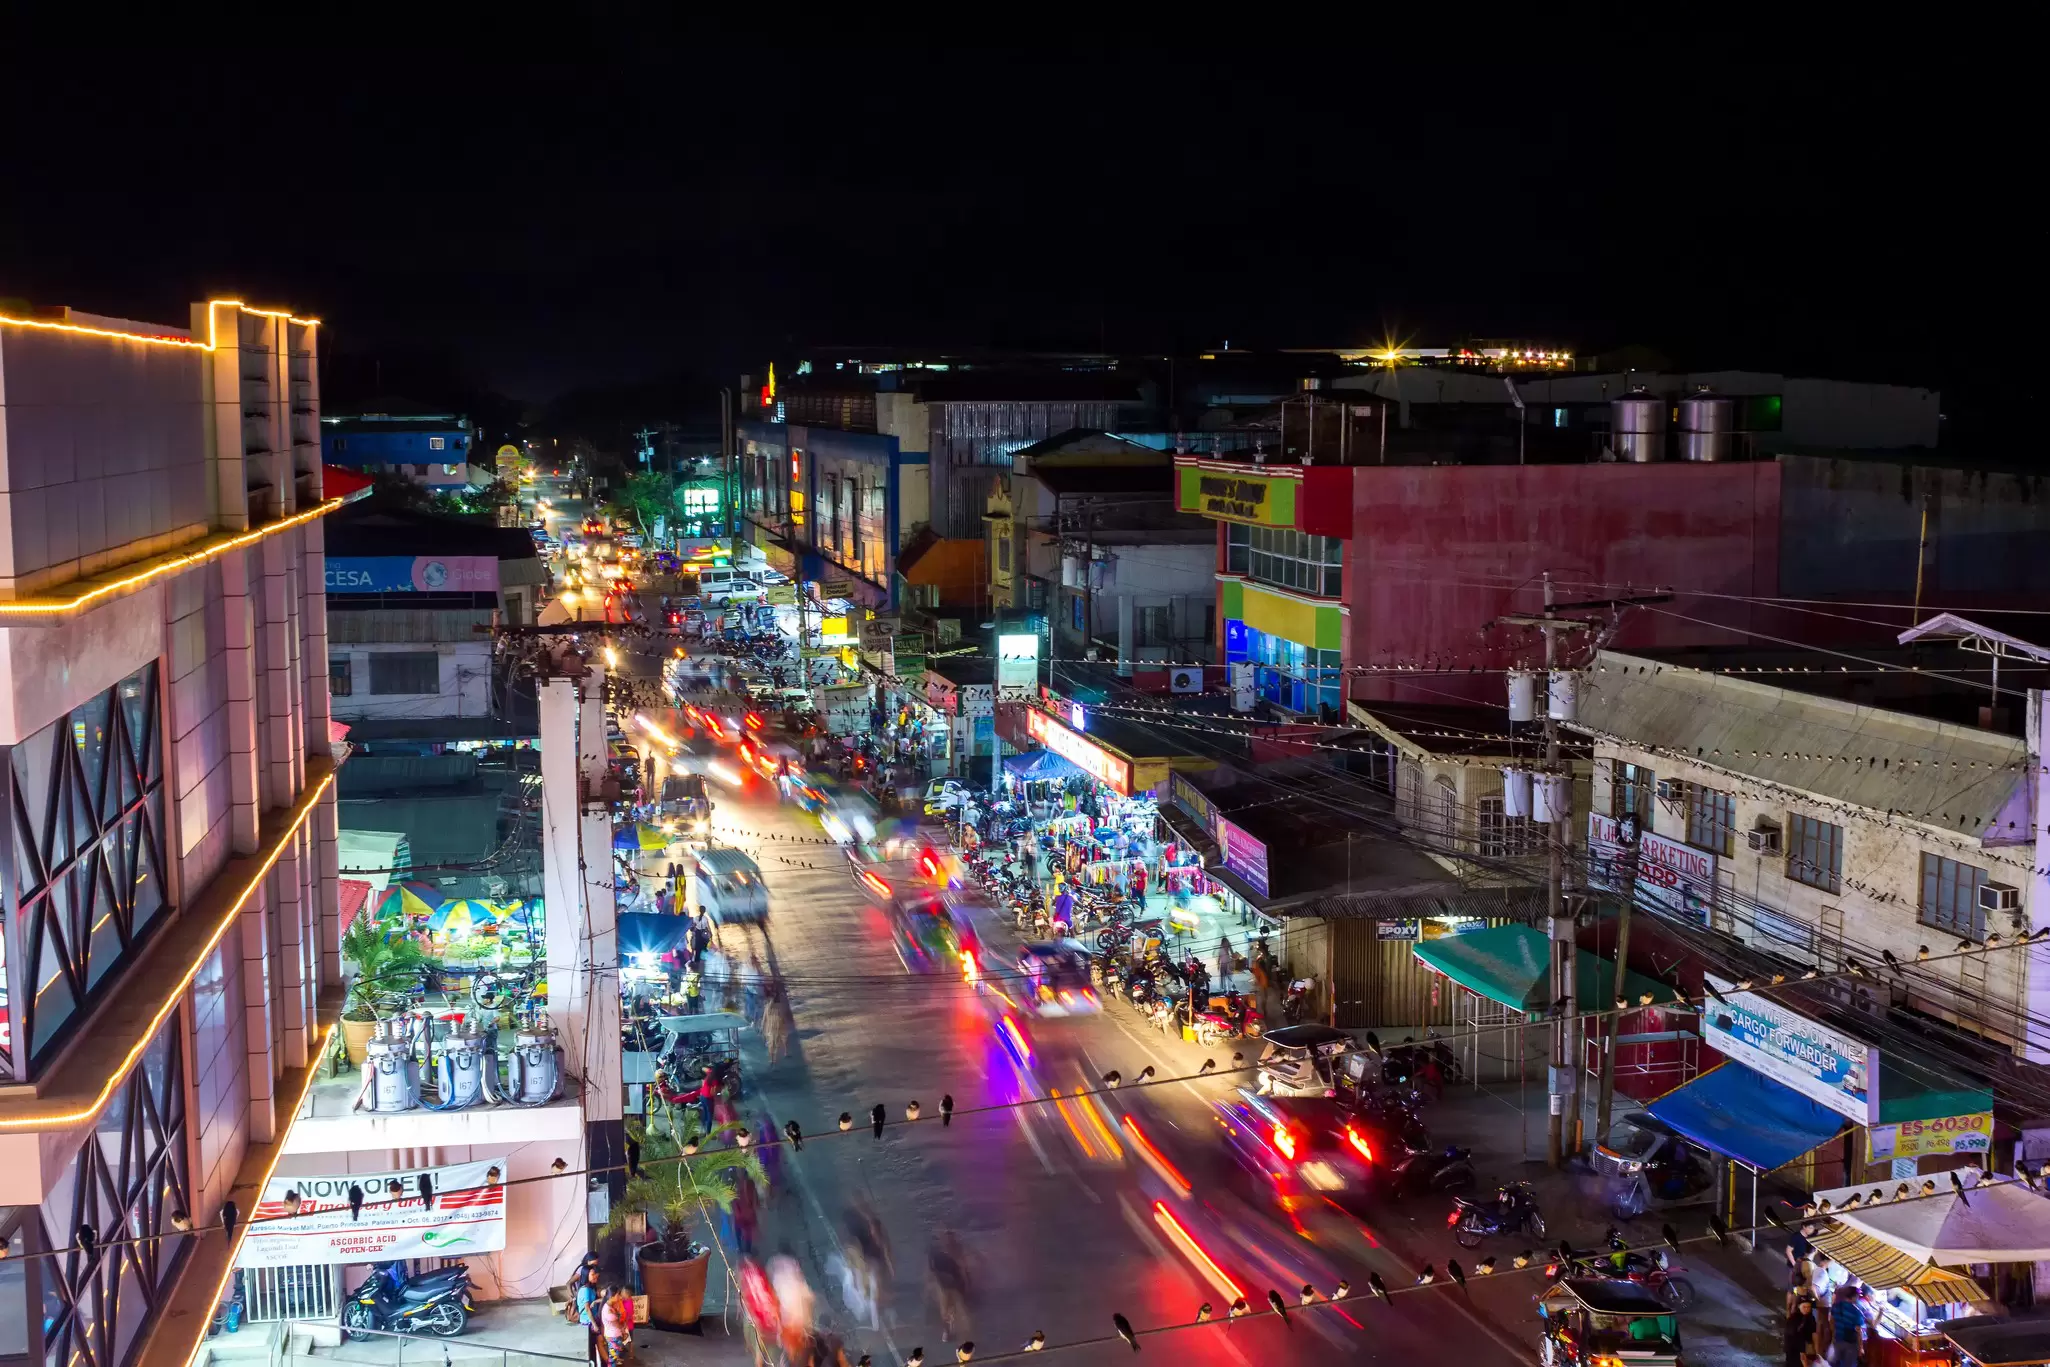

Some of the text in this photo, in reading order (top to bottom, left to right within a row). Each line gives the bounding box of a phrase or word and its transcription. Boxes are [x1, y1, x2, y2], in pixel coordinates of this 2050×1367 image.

[453, 568, 492, 581] Globe
[1640, 836, 1711, 879] ARKETING
[1378, 926, 1417, 935] EPOXY
[1763, 1005, 1808, 1039] WHEELS
[1730, 1009, 1767, 1038] CARGO
[1769, 1026, 1838, 1074] FORWARDER
[459, 1081, 472, 1091] 167
[530, 1076, 543, 1086] 167
[383, 1085, 397, 1095] 167
[1901, 1116, 1983, 1137] ES-6030
[296, 1180, 357, 1199] NOW
[317, 1221, 339, 1230] Puerto
[330, 1235, 397, 1246] ASCORBIC ACID
